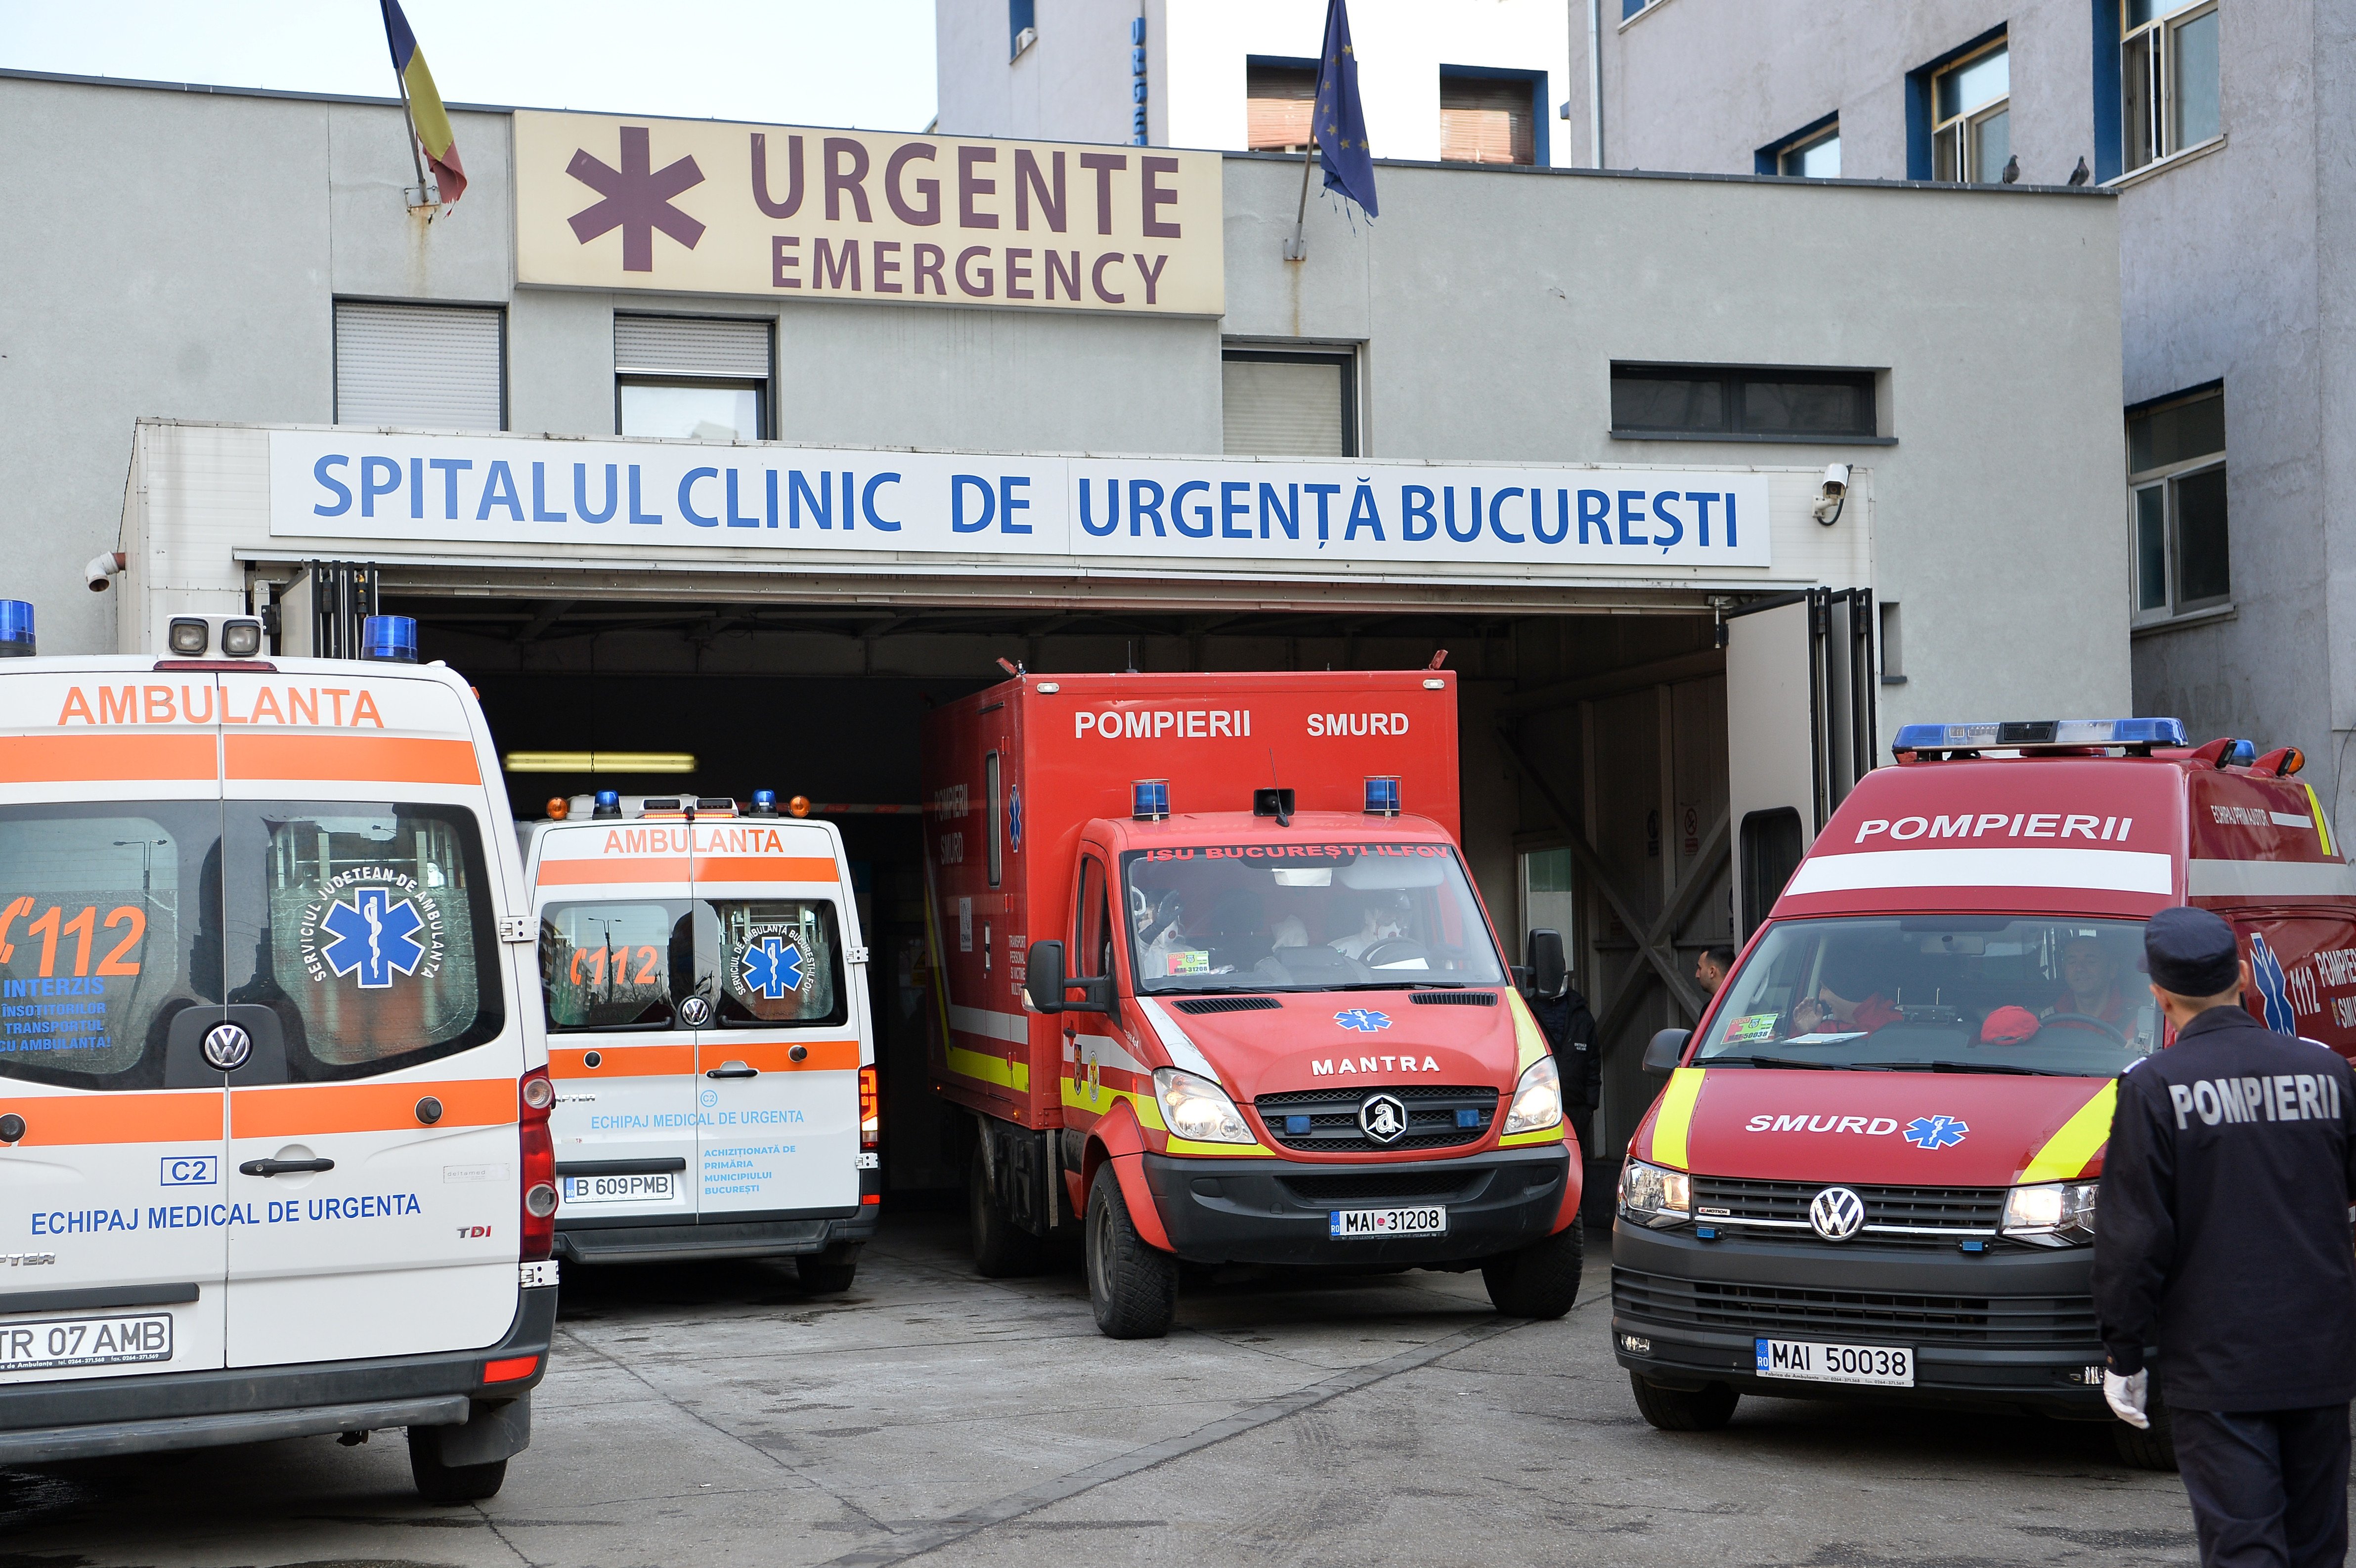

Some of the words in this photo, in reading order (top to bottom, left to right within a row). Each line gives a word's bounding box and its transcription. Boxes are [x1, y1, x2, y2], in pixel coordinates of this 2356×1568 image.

[1132, 17, 1147, 145] URGE
[751, 133, 1181, 239] URGENTE
[772, 235, 1168, 305] EMERGENCY
[313, 454, 663, 524] SPITALUL
[678, 466, 902, 532] CLINIC
[952, 474, 1032, 535] DE
[1079, 476, 1386, 549] URGENȚĂ
[1403, 483, 1738, 556] BUCUREȘTI
[57, 686, 385, 728] AMBULANTA
[1075, 710, 1251, 739] POMPIERII
[1307, 713, 1409, 737] SMURD
[935, 784, 968, 822] POMPIERII
[604, 829, 784, 853] AMBULANTA
[1854, 814, 2133, 844] POMPIERII
[941, 832, 963, 865] SMURD
[1147, 849, 1194, 863] ISU
[1376, 845, 1448, 859] ILFOV
[300, 904, 326, 982] SERVICIUL
[318, 867, 393, 901] JUDETEAN
[396, 873, 417, 893] DE
[414, 891, 444, 978] AMBULANTA
[29, 906, 146, 977] 112
[734, 942, 745, 955] DE
[589, 945, 658, 985] 112
[730, 955, 746, 996] SERVICIUL
[3, 976, 105, 998] INTERZIS
[4, 1020, 104, 1034] TRANSPORTUL
[0, 1040, 16, 1052] CU
[1311, 1056, 1440, 1076] MANTRA
[2168, 1074, 2341, 1130] POMPIERII
[591, 1115, 649, 1129] ECHIPAJ
[654, 1113, 714, 1127] MEDICAL
[719, 1112, 736, 1125] DE
[741, 1110, 804, 1124] URGENTA
[1745, 1115, 1898, 1135] SMURD
[172, 1161, 207, 1180] C2
[704, 1160, 753, 1170] PRIMĂRIA
[704, 1172, 772, 1182] MUNICIPIULUI
[576, 1179, 589, 1196] B
[32, 1208, 138, 1235] ECHIPAJ
[148, 1203, 260, 1229] MEDICAL
[268, 1200, 299, 1223] DE
[308, 1193, 421, 1220] URGENTA
[1331, 1224, 1340, 1233] RO
[1346, 1212, 1375, 1232] MAI
[1387, 1210, 1440, 1230] 31208
[457, 1225, 492, 1239] TDI
[48, 1325, 87, 1356] 07
[93, 1321, 165, 1353] AMB
[1757, 1356, 1768, 1367] RO
[1773, 1343, 1810, 1371] MAI
[1826, 1347, 1907, 1376] 50038
